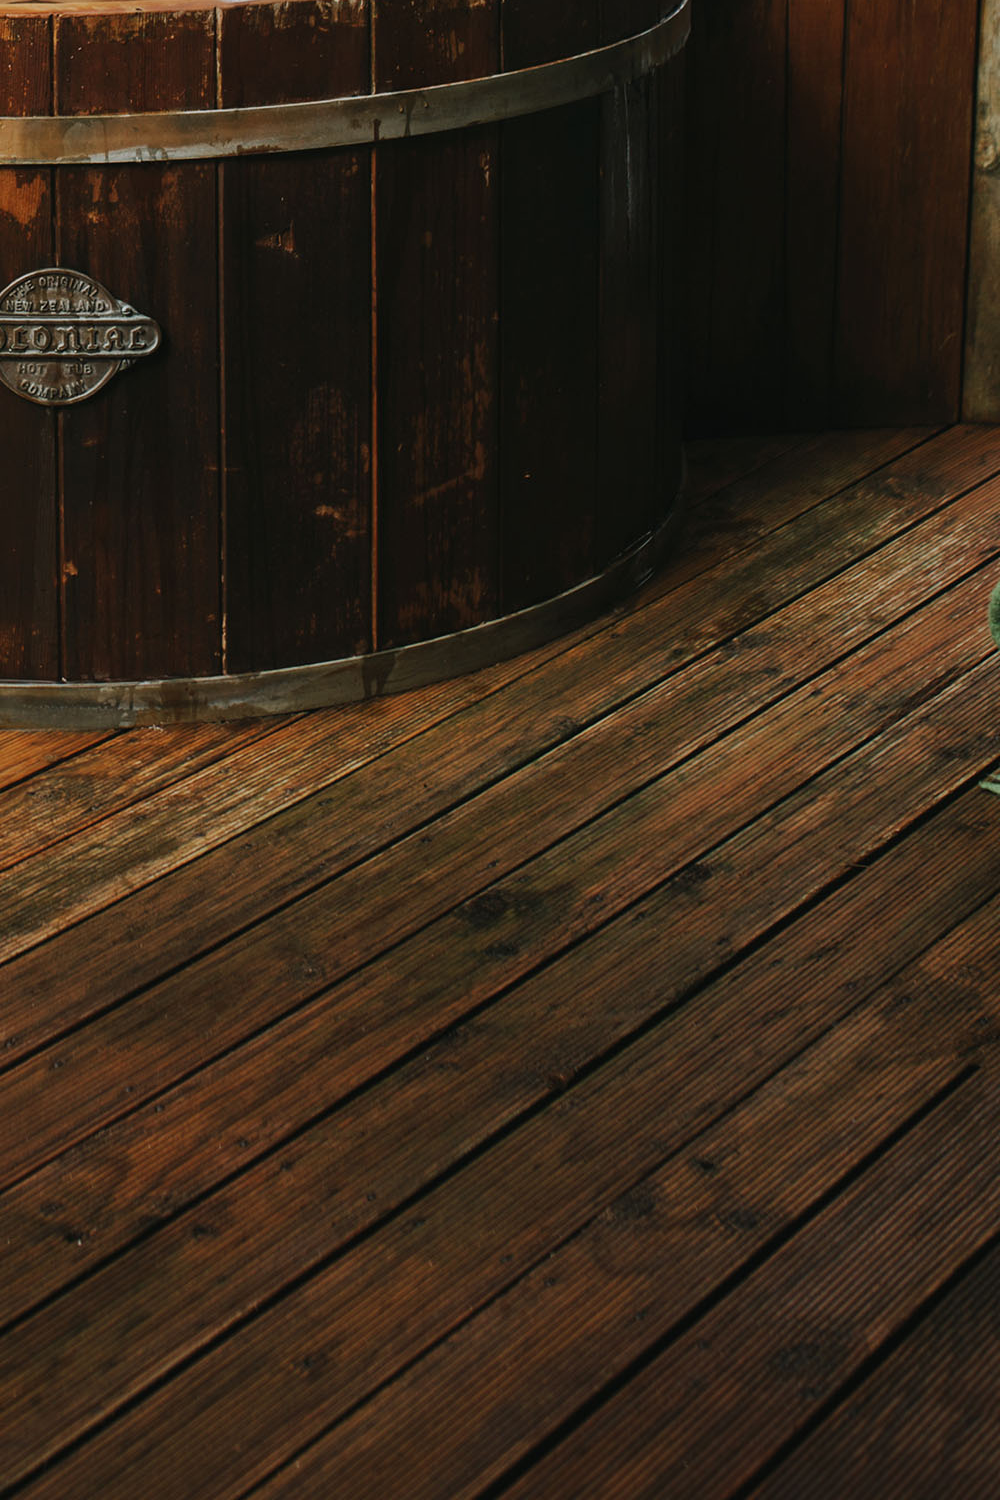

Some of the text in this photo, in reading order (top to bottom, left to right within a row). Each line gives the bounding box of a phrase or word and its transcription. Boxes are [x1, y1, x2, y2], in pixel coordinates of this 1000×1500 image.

[9, 275, 98, 300] THE ORIGINAL
[6, 298, 105, 312] NEW ZEALAND
[19, 363, 93, 375] HOT TUB
[20, 379, 87, 398] COMPANY
